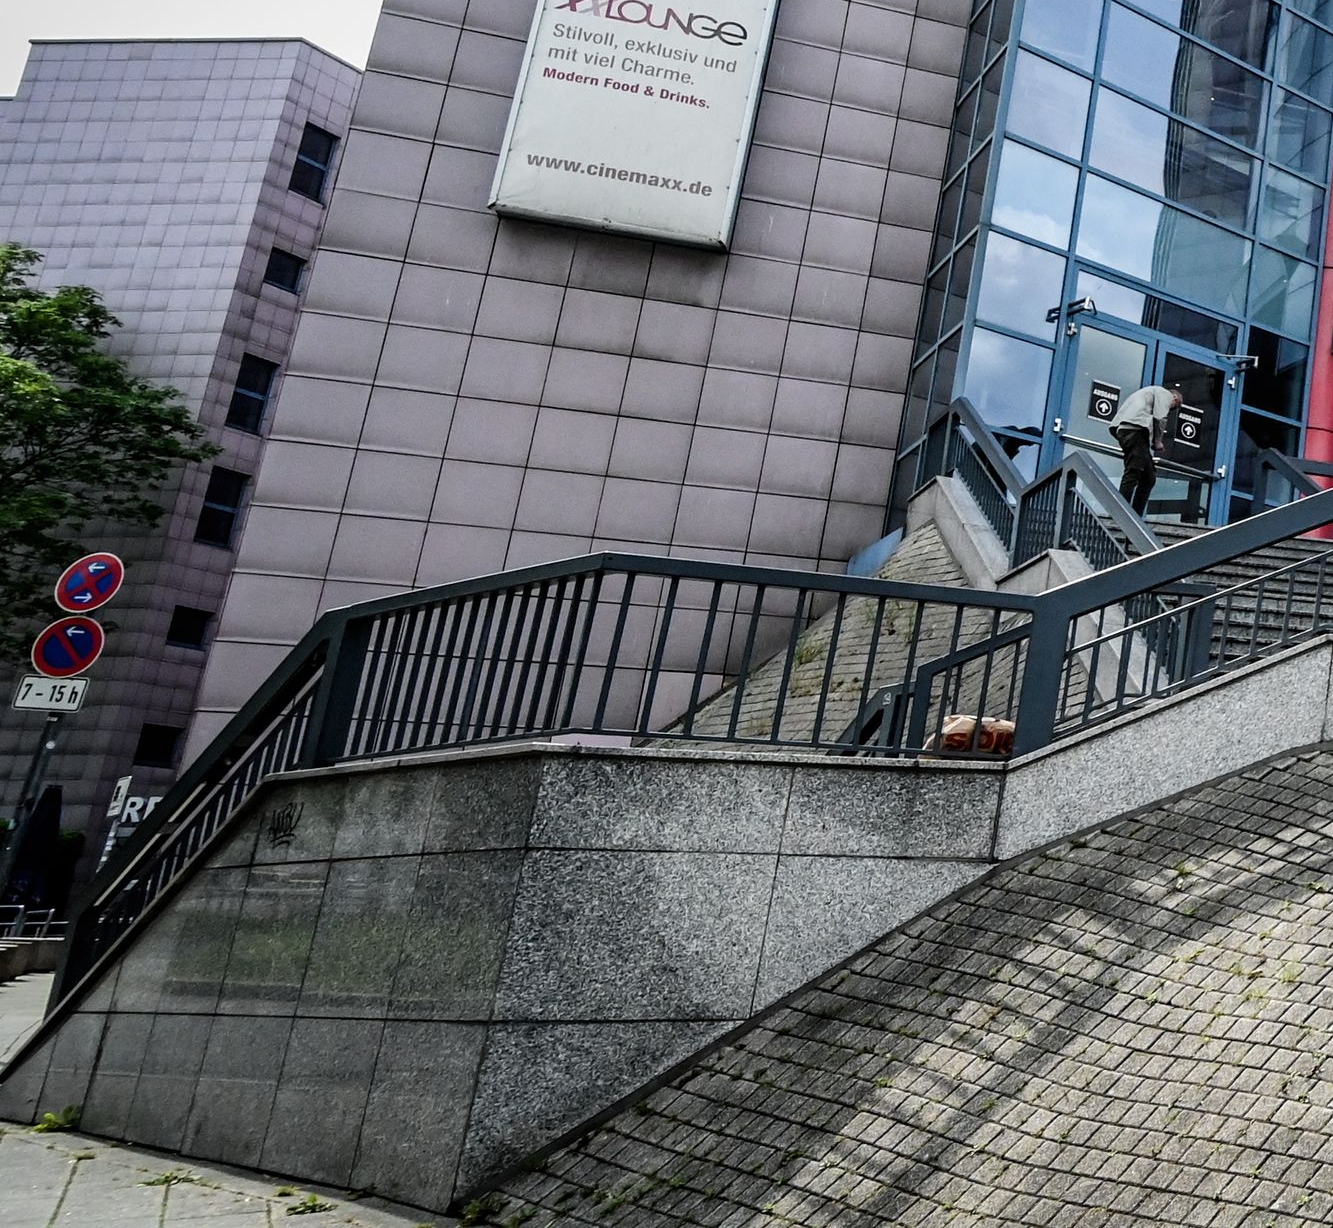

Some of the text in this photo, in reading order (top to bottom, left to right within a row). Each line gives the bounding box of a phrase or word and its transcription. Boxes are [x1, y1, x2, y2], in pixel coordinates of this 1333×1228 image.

[548, 45, 695, 85] mit viel Charme.
[553, 23, 737, 73] Stilvoll, exklusiv und
[543, 67, 711, 109] Modern Food & Drinks.
[527, 153, 713, 197] www.cinemaxx.de
[21, 683, 33, 700] 7
[49, 685, 67, 702] 15
[68, 686, 78, 703] h
